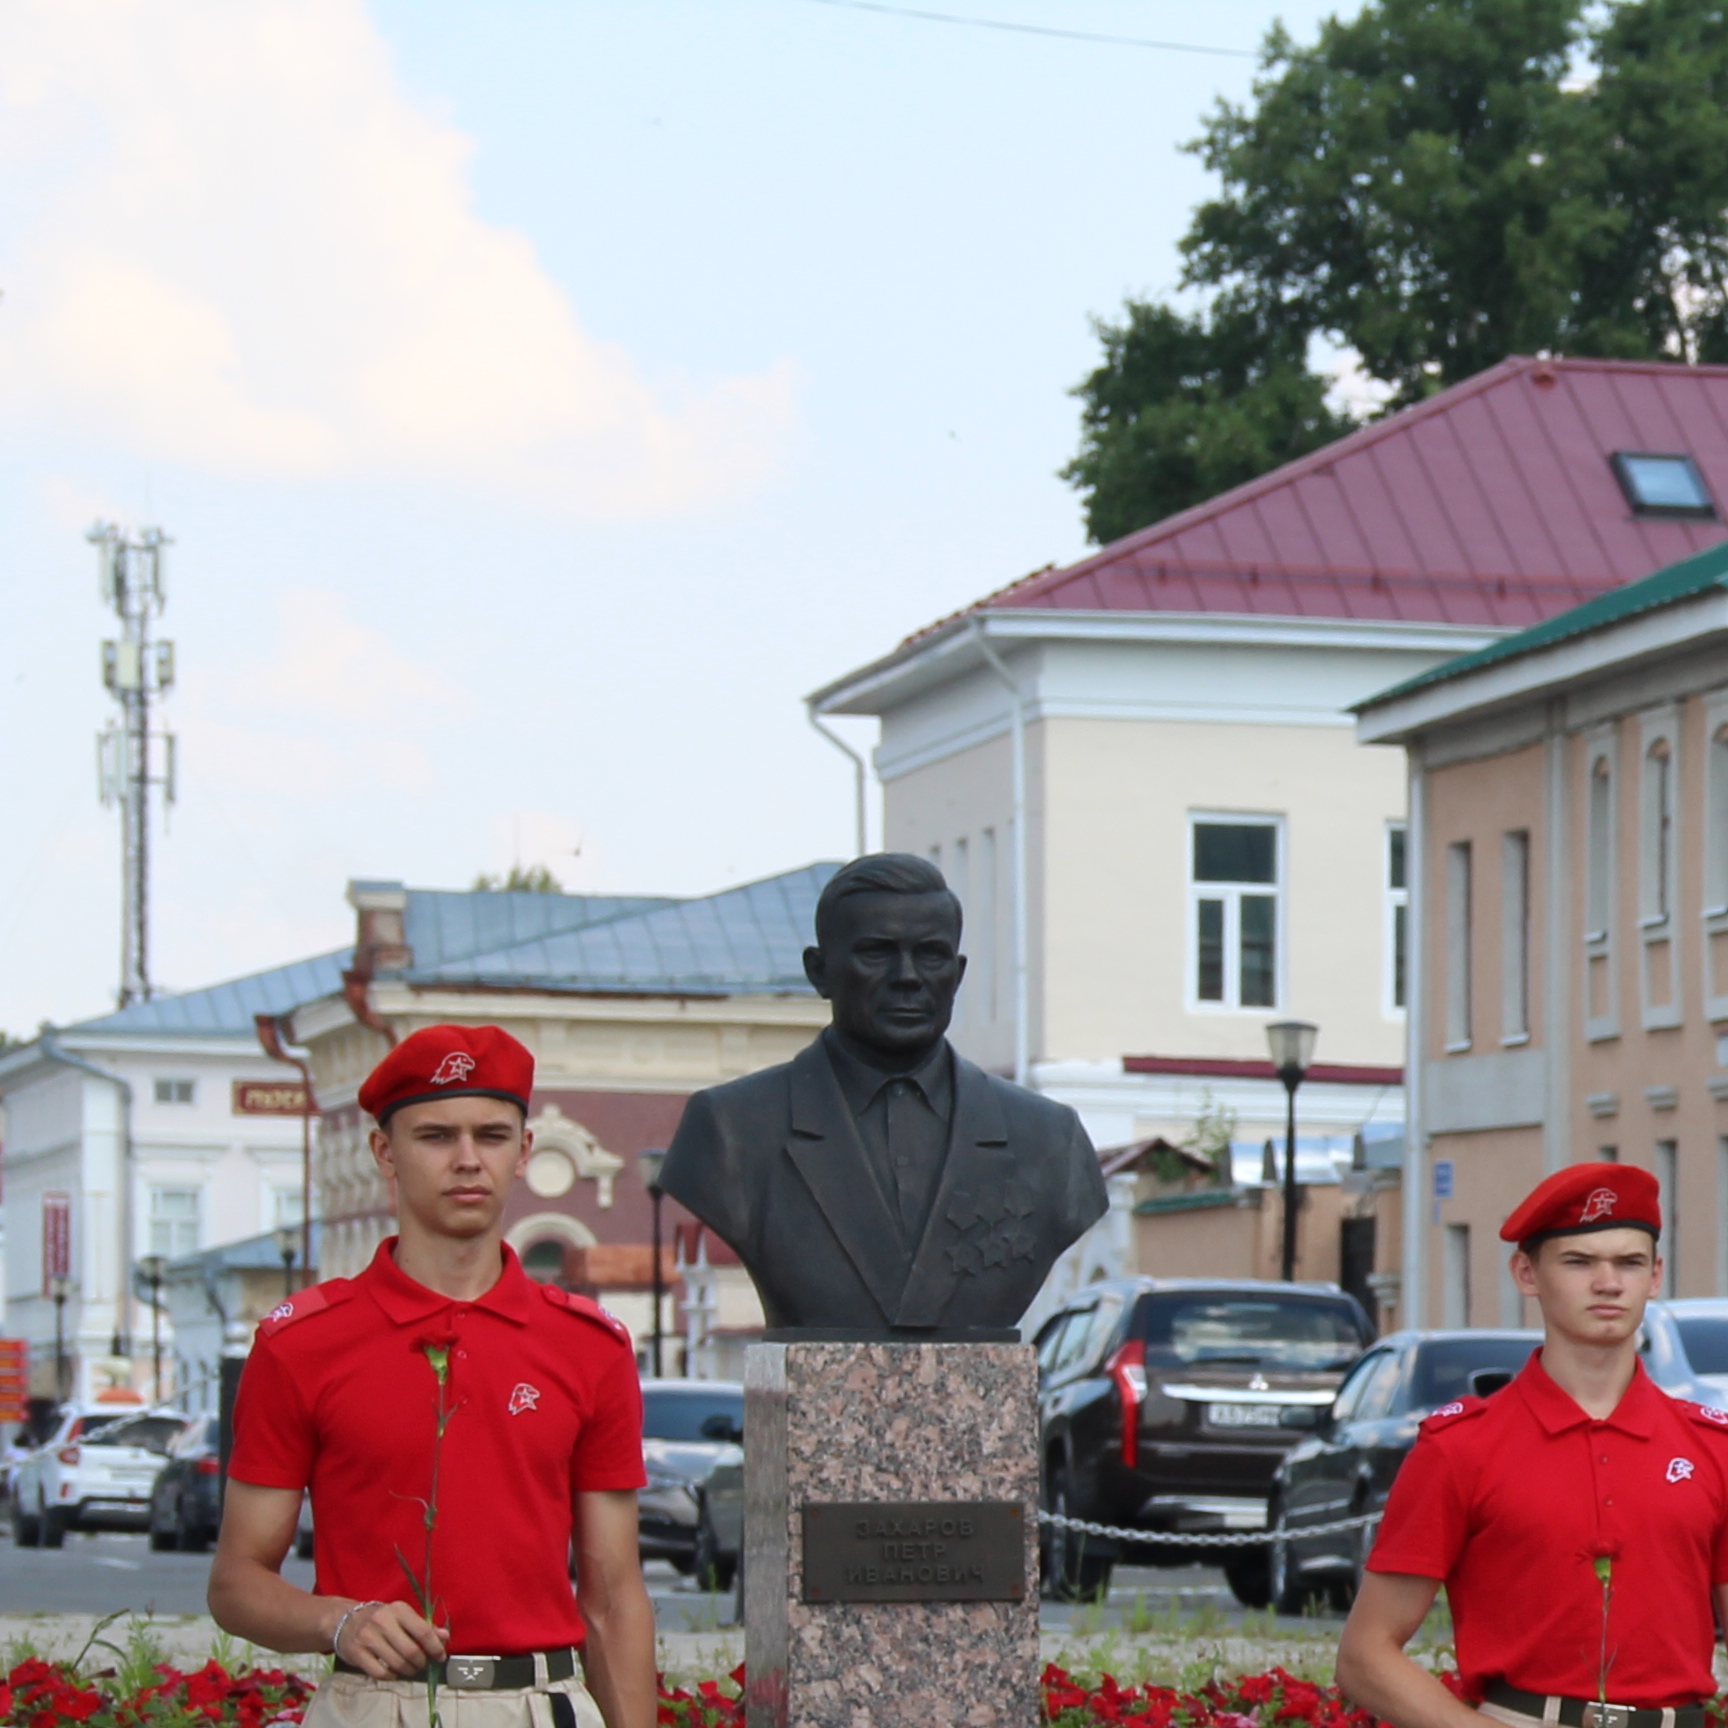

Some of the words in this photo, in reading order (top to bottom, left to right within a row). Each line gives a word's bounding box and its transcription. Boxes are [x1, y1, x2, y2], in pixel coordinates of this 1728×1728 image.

[855, 1518, 975, 1539] ЗАХАРОВ
[881, 1541, 947, 1561] ПЕТР
[845, 1565, 985, 1584] ИВАНОВИЧ
